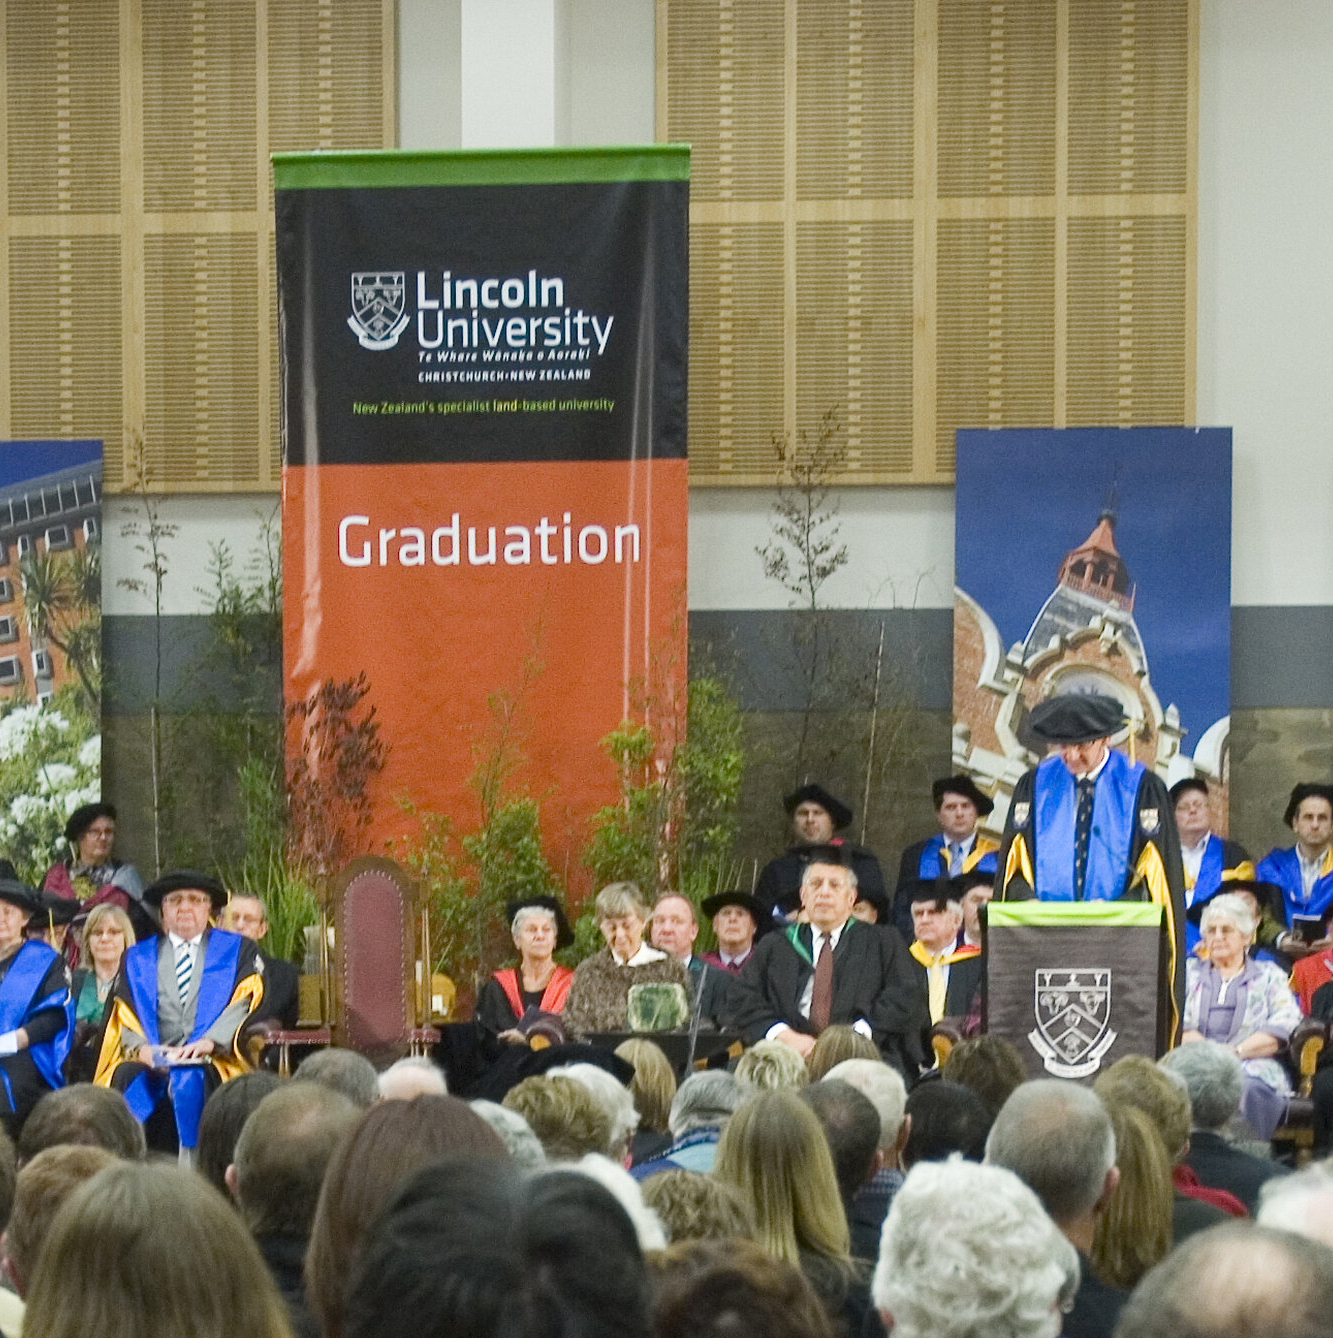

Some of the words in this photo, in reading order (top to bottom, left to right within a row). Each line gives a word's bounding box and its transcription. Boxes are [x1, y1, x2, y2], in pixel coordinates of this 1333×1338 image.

[417, 269, 564, 309] Lincoln
[417, 307, 615, 355] University
[418, 350, 432, 363] Te
[437, 350, 477, 362] Whare
[539, 368, 591, 381] ZEALAND
[353, 401, 378, 414] New
[381, 400, 435, 414] Zealand's
[437, 399, 490, 415] specialist
[559, 397, 615, 413] university
[338, 512, 640, 567] Graduation
